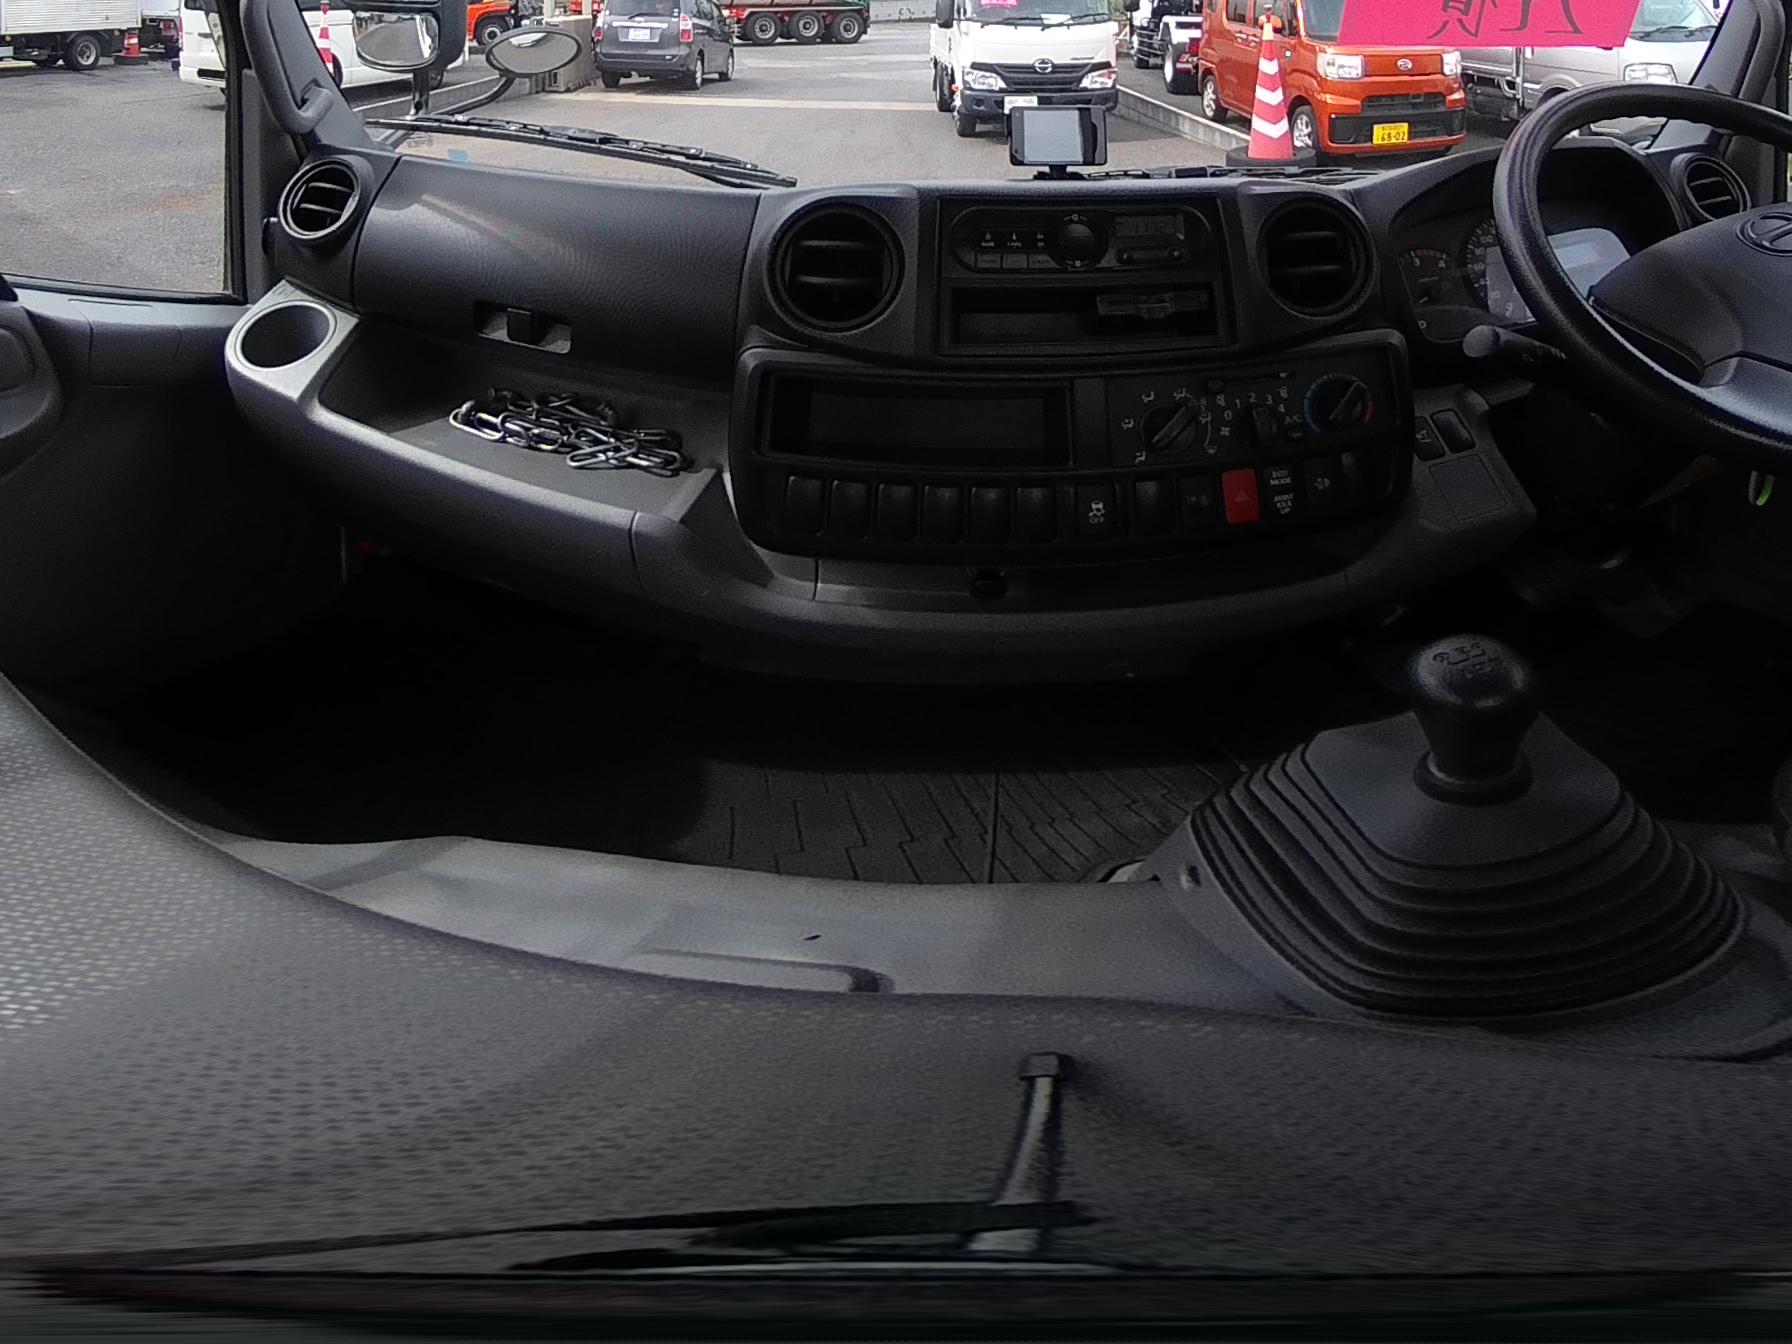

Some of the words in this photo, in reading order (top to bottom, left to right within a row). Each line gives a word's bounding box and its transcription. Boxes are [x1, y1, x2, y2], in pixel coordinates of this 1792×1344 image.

[1380, 131, 1406, 142] 68-02
[1412, 257, 1420, 267] 3
[1437, 259, 1447, 269] 4
[1248, 392, 1257, 403] 2
[1265, 393, 1273, 405] 3
[1234, 399, 1242, 409] 1
[1276, 403, 1286, 413] 4
[1224, 409, 1233, 421] 0
[1284, 414, 1304, 425] A/C
